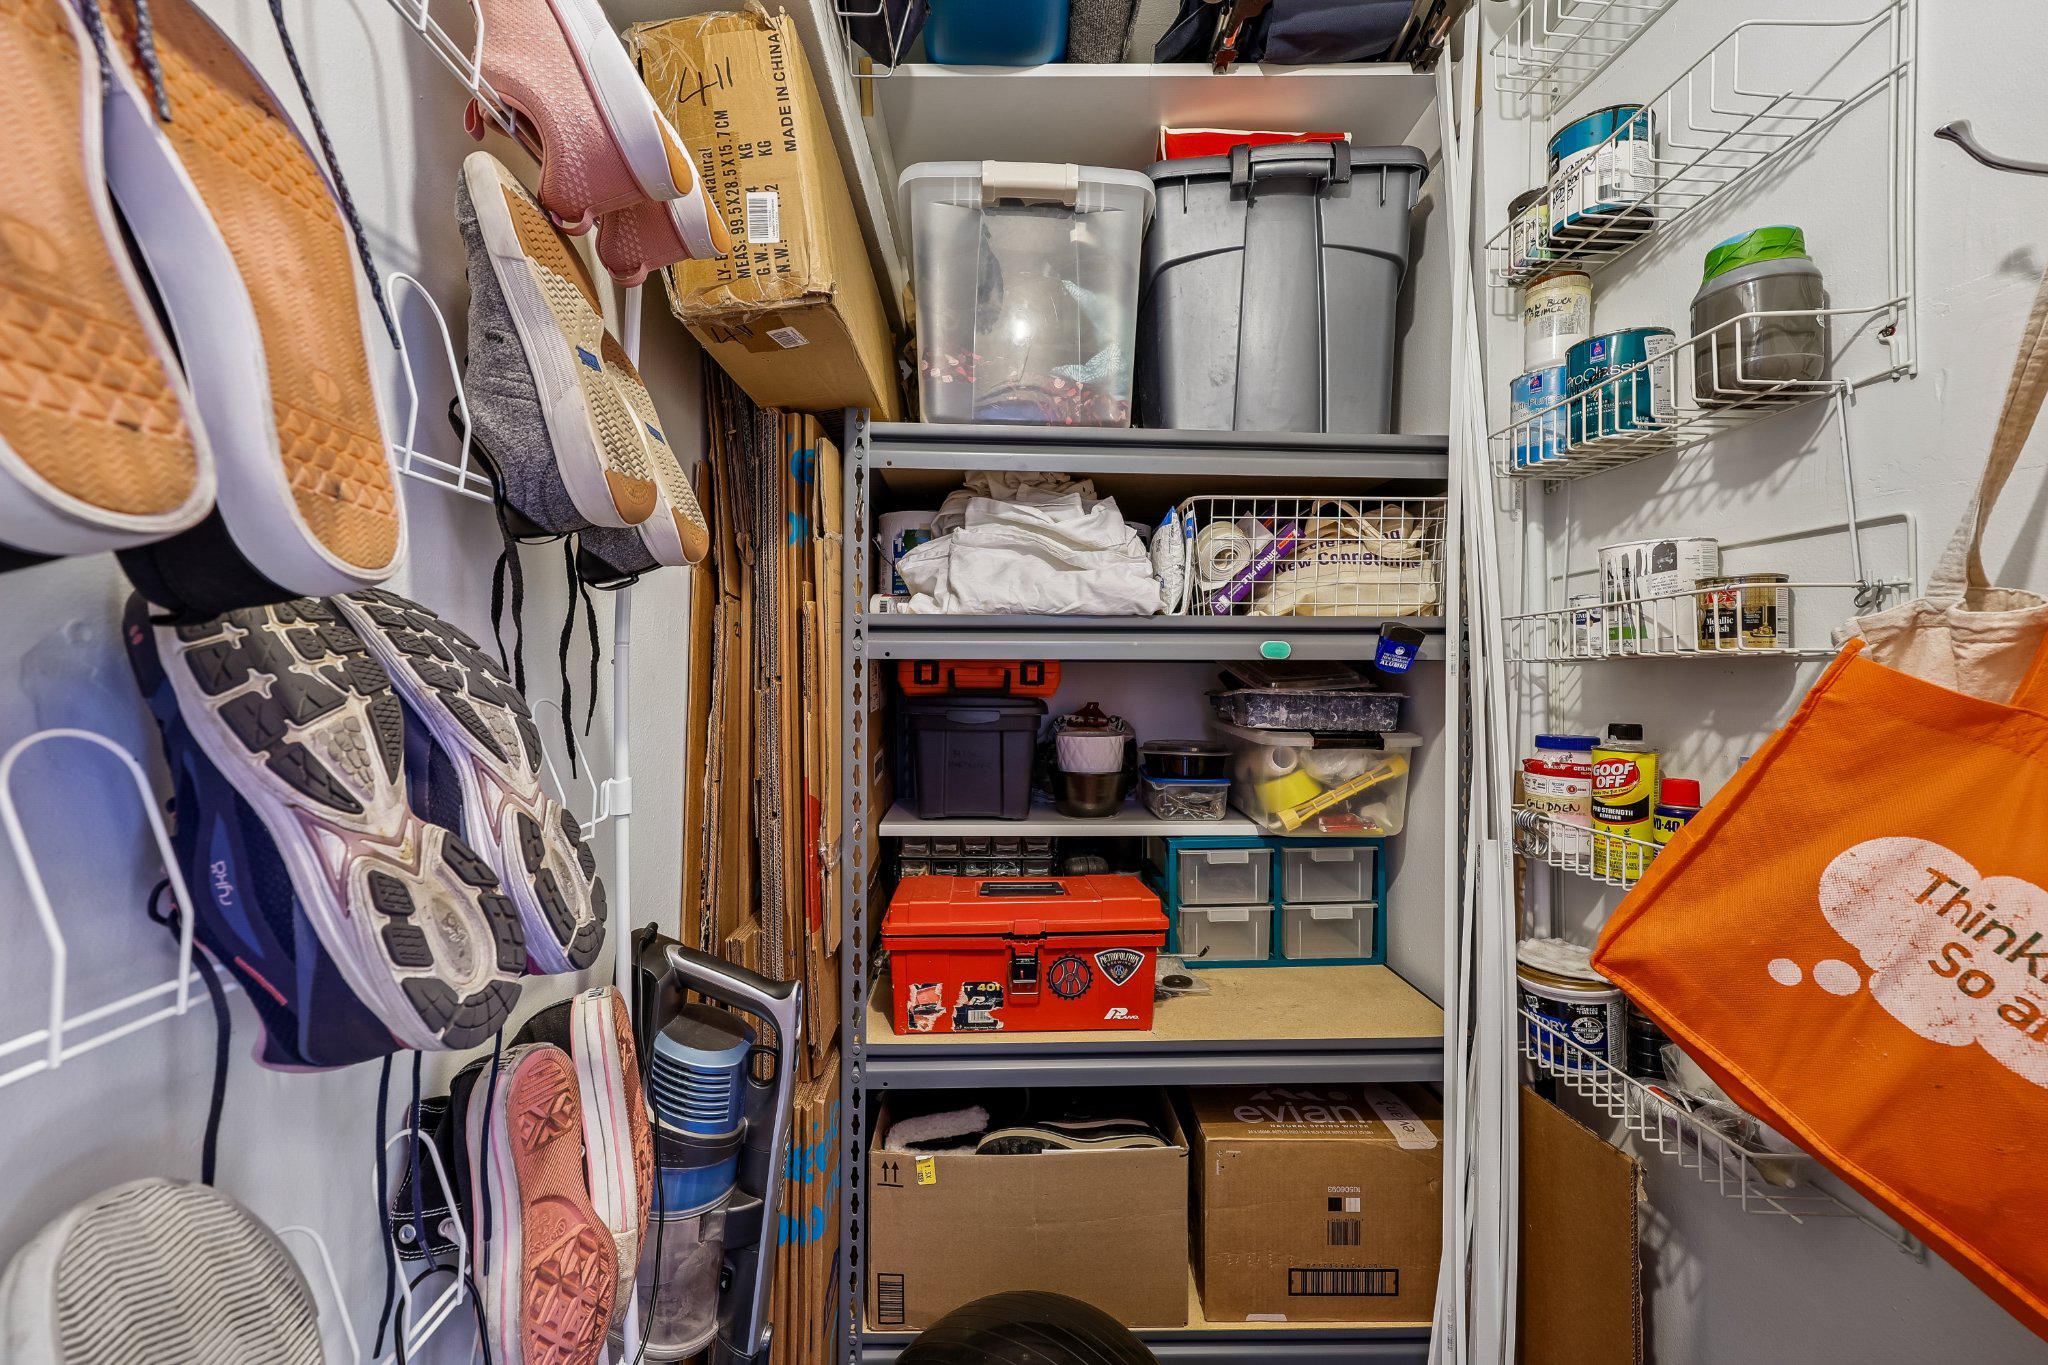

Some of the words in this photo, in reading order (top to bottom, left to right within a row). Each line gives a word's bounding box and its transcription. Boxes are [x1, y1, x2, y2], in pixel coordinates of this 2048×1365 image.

[767, 32, 786, 82] CHINA
[775, 86, 790, 102] IN
[778, 105, 797, 153] MADE
[738, 142, 754, 159] KG
[757, 139, 773, 157] KG
[732, 239, 752, 280] MEAS:
[753, 243, 771, 277] G.W.:
[773, 239, 792, 274] N.W.:
[1255, 548, 1278, 572] BRUSH
[1275, 557, 1312, 574] New
[1706, 616, 1734, 626] Meallic
[1708, 625, 1731, 633] Fiish
[1592, 761, 1637, 777] GOOF
[1595, 775, 1627, 789] OFF
[1526, 798, 1581, 813] GLIDDEN
[1602, 807, 1634, 817] STRENGTH
[1653, 817, 1681, 833] D-40
[1099, 952, 1141, 967] METROPOLITAN
[1928, 941, 1996, 999] So
[1233, 1101, 1366, 1125] evian
